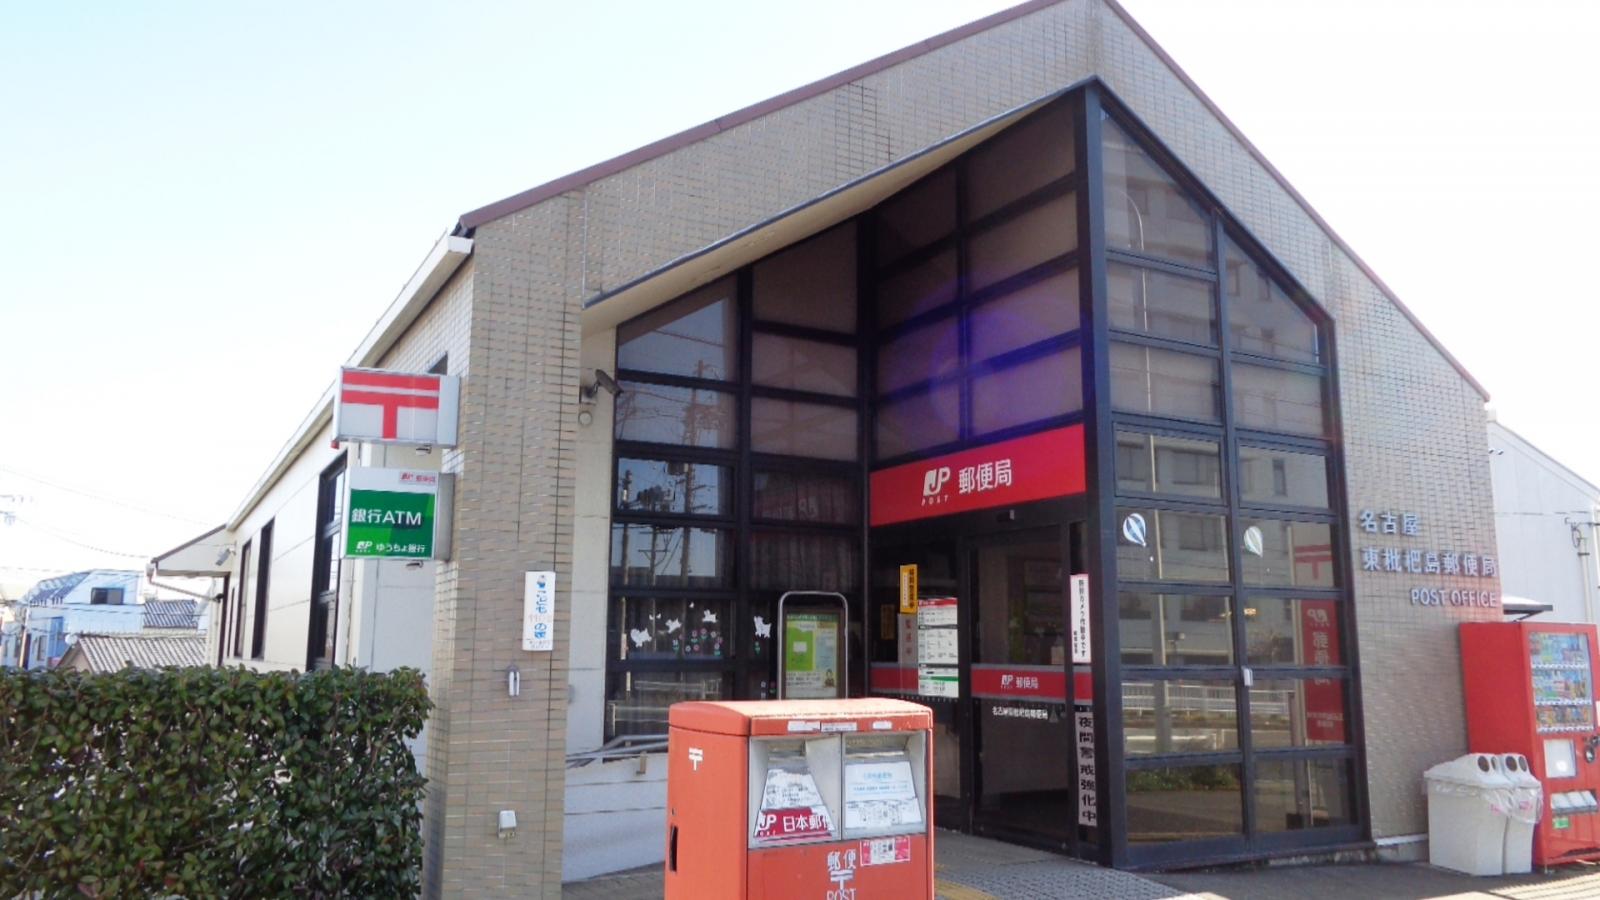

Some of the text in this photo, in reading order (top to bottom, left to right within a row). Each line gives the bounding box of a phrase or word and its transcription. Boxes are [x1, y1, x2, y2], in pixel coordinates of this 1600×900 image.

[922, 458, 1012, 497] JP 郵便局
[351, 507, 423, 526] 銀行ATM
[1360, 509, 1421, 537] 名古屋
[376, 542, 426, 554] ゆうちょ銀行
[1361, 547, 1498, 577] 東枇杷島郵便局
[1411, 587, 1498, 609] POST OFFICE
[827, 848, 857, 870] 郵便
[826, 888, 857, 900] POST
